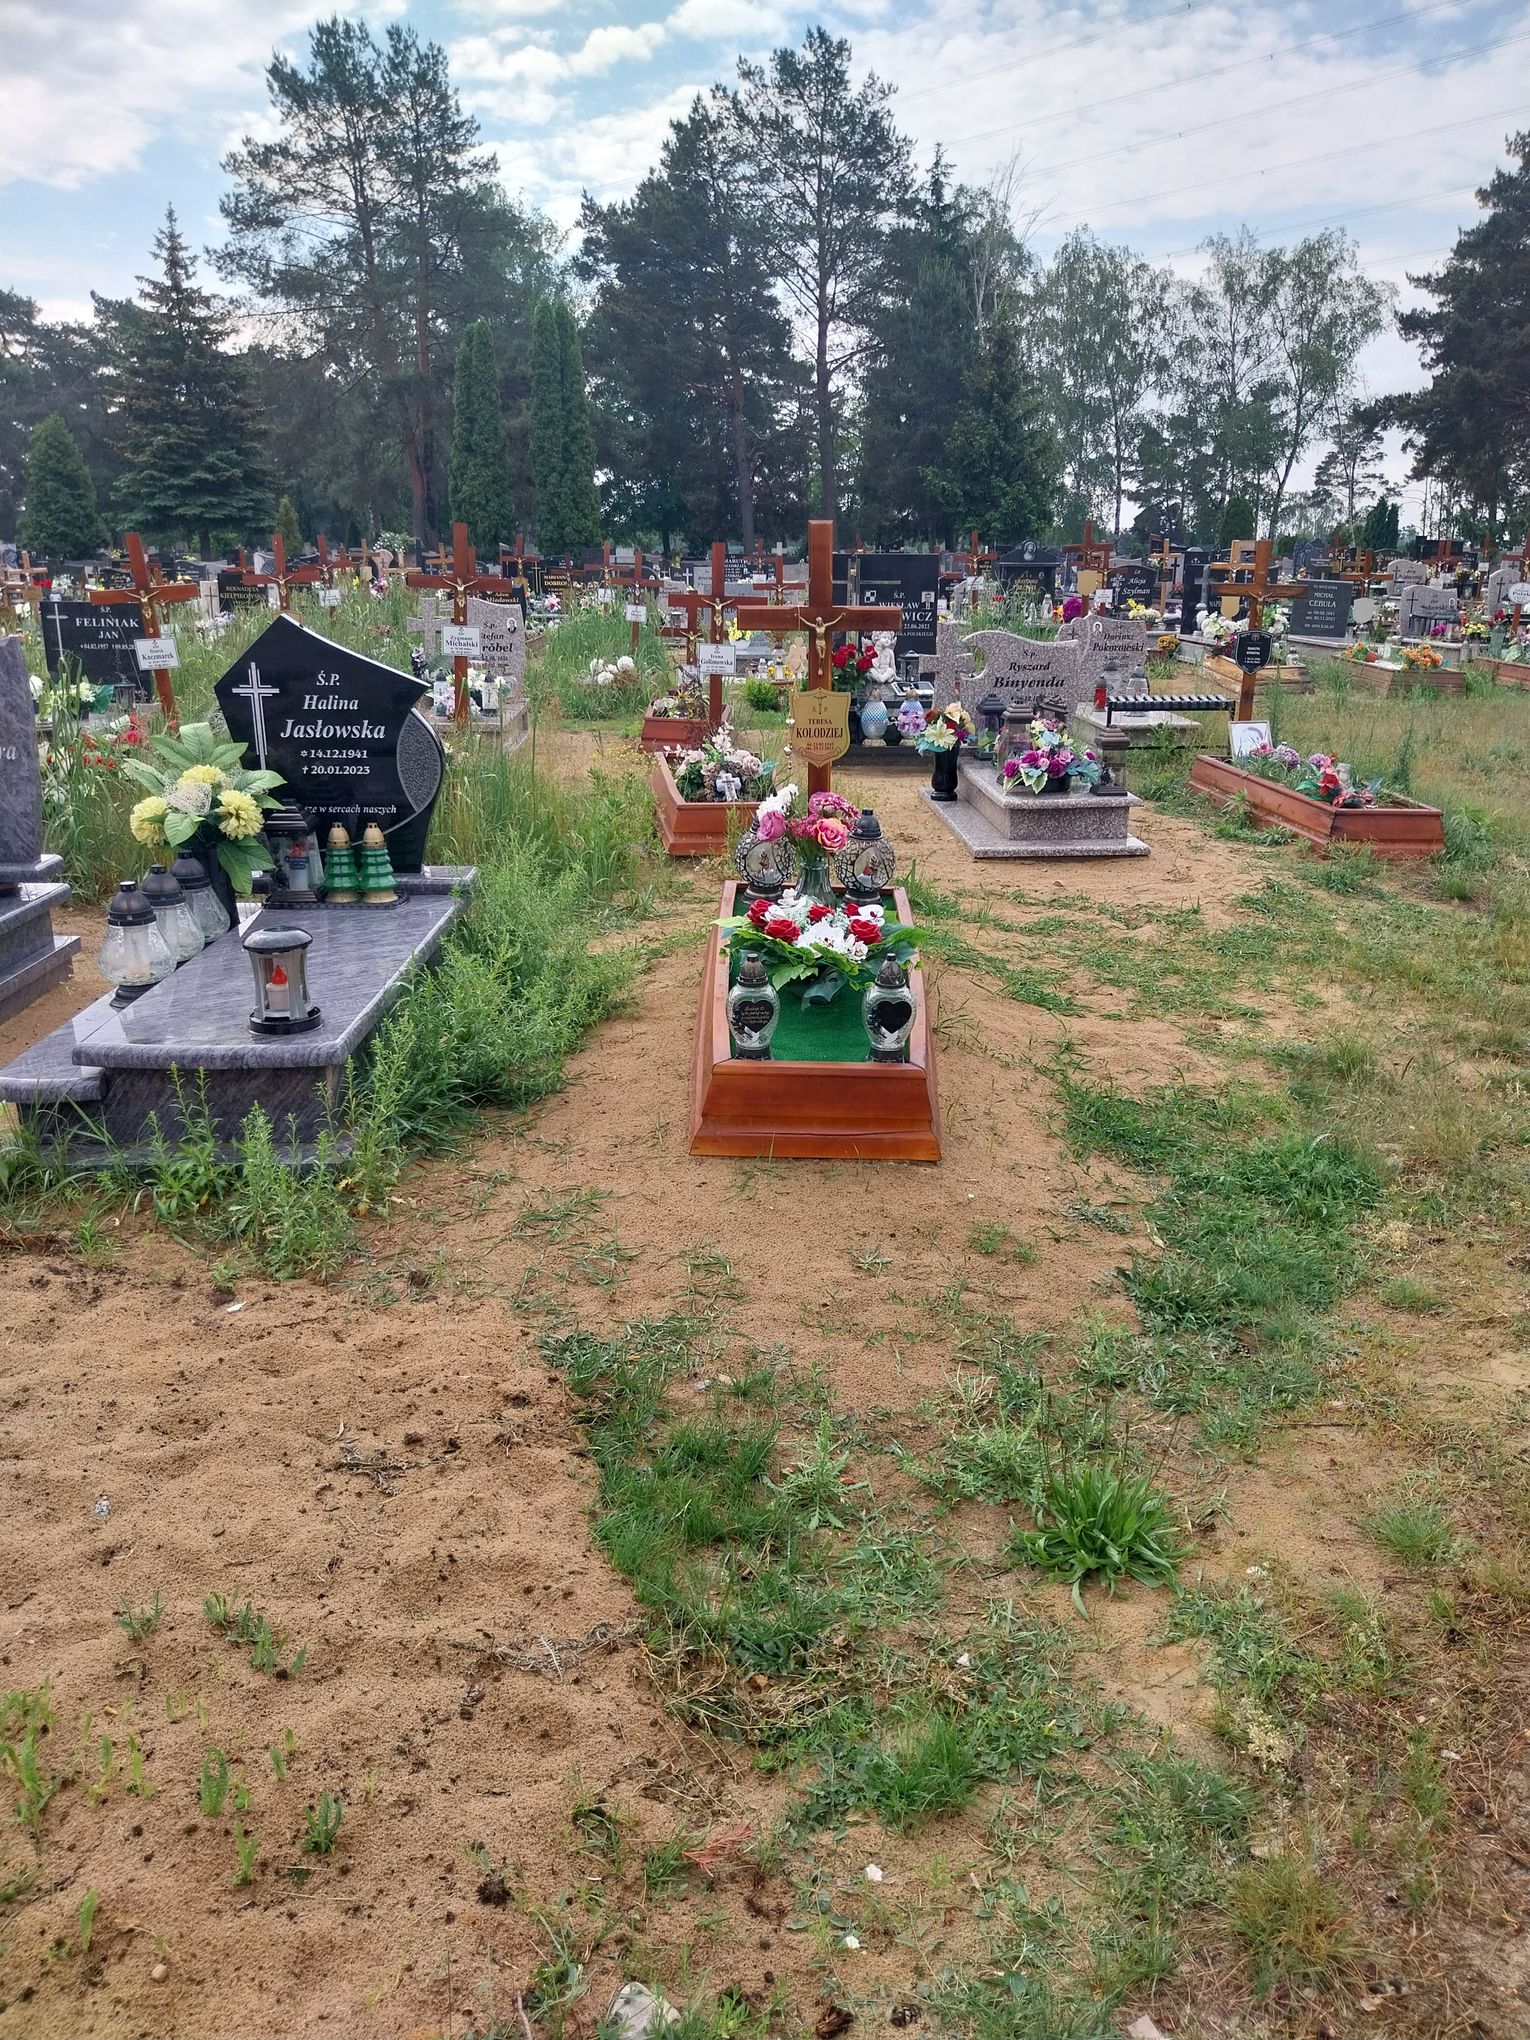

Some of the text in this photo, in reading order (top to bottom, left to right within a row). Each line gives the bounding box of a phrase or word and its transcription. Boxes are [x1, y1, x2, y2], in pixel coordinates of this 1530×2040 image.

[1122, 587, 1151, 597] Szylman
[1309, 600, 1337, 608] CEBULA
[75, 617, 140, 627] FELINIAK
[901, 612, 933, 622] WICZ
[98, 630, 119, 639] JAN
[481, 632, 504, 640] tefan
[445, 640, 479, 648] Michalski
[482, 642, 513, 653] róbel
[1092, 642, 1145, 652] Pokorowski
[1009, 662, 1051, 674] Ryszard
[316, 670, 341, 686] Ś.P.
[993, 676, 1065, 691] Binyenda
[302, 694, 359, 710] Halina
[280, 719, 386, 739] Jasłowska
[796, 727, 844, 738] KOŁODZIEJ
[310, 765, 371, 775] 20.01.2023
[329, 804, 361, 814] sercach
[363, 804, 397, 816] naszych
